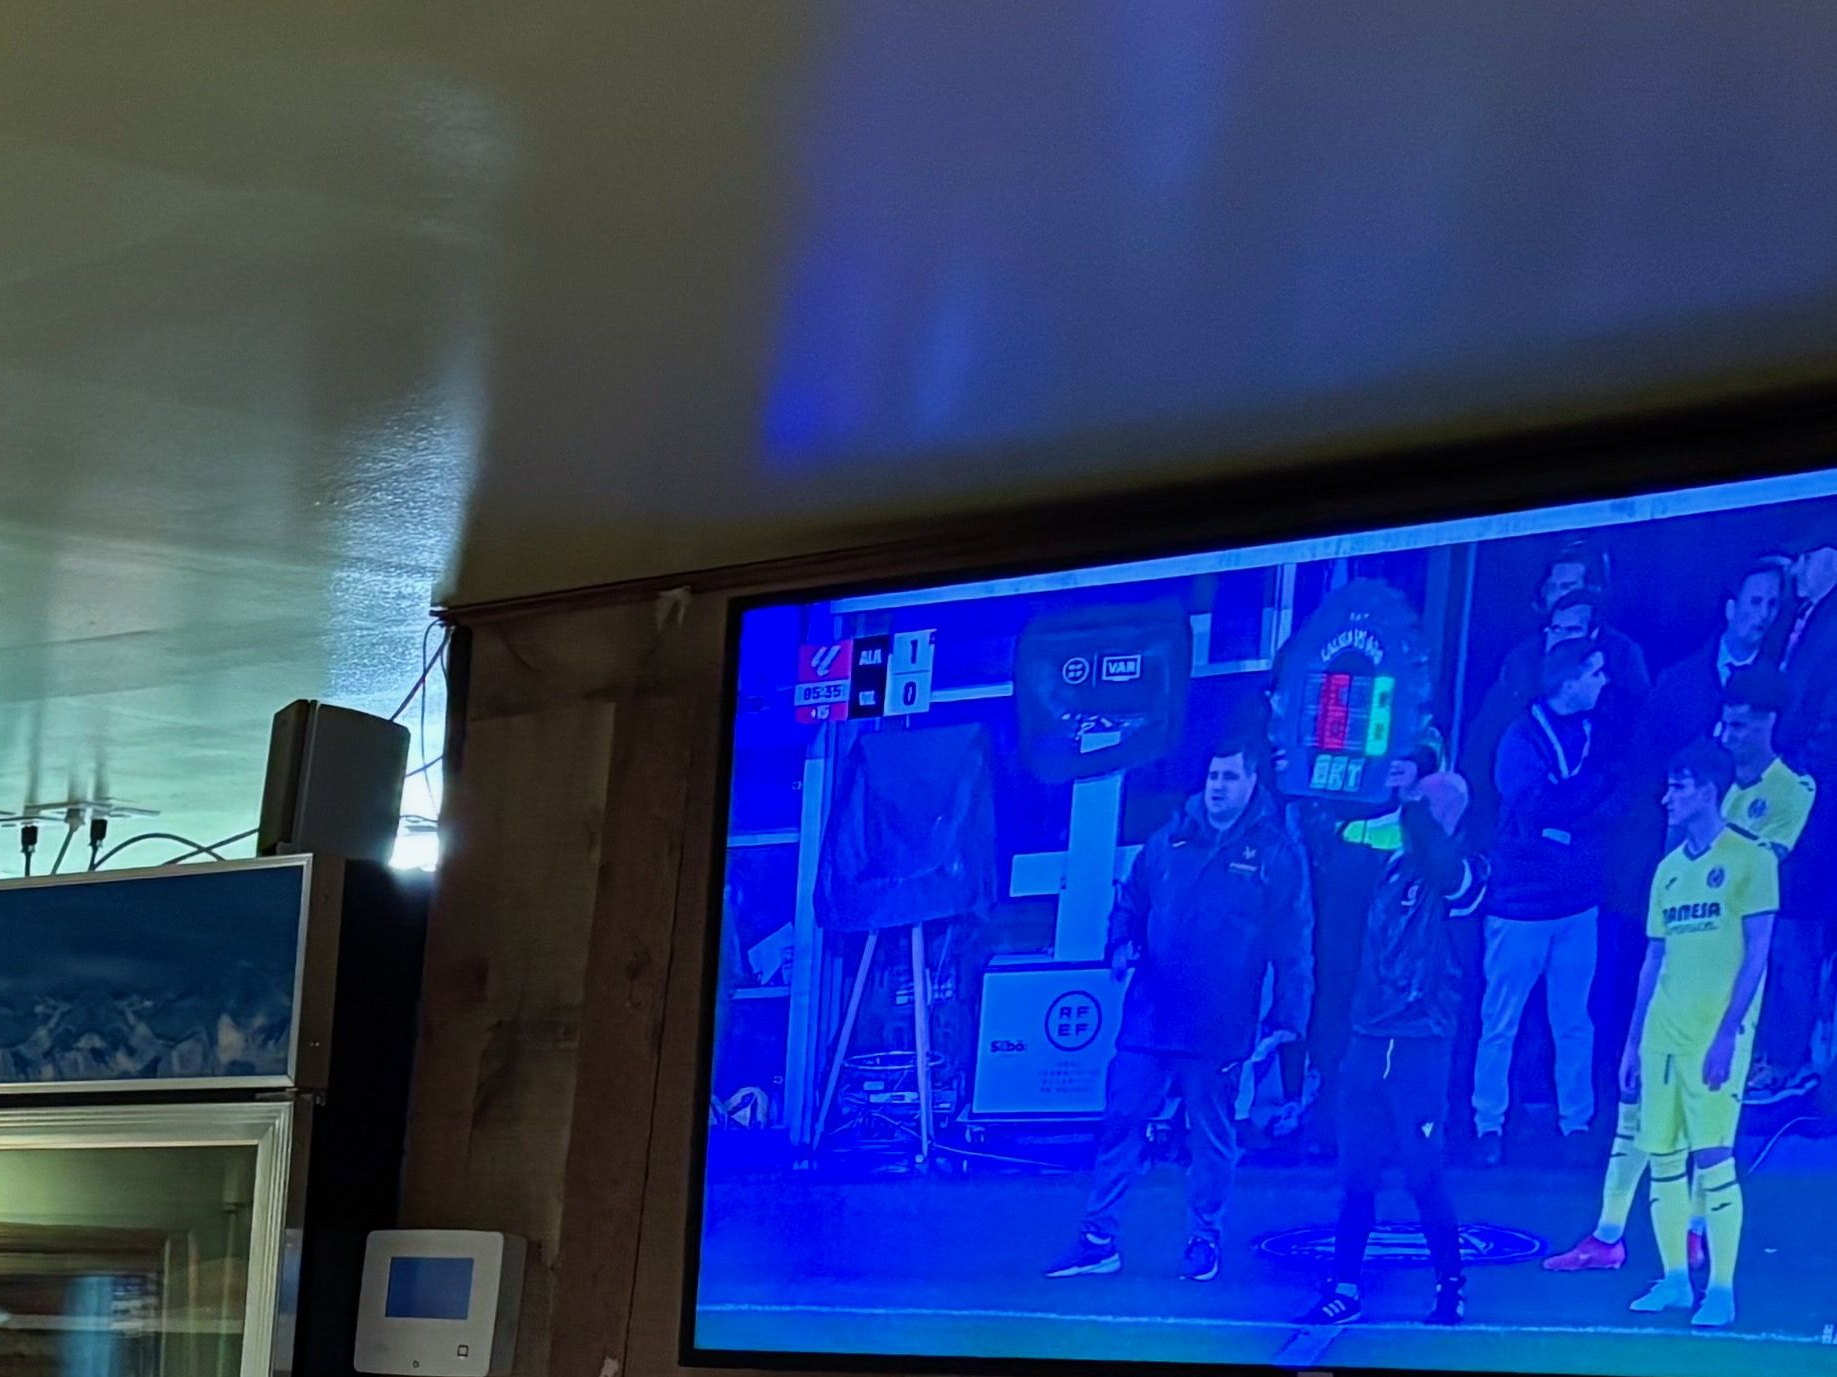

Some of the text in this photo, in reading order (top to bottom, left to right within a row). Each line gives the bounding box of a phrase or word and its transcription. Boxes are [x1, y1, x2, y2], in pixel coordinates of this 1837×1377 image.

[910, 639, 919, 665] 1
[1108, 661, 1136, 674] VAR
[902, 681, 917, 706] 0
